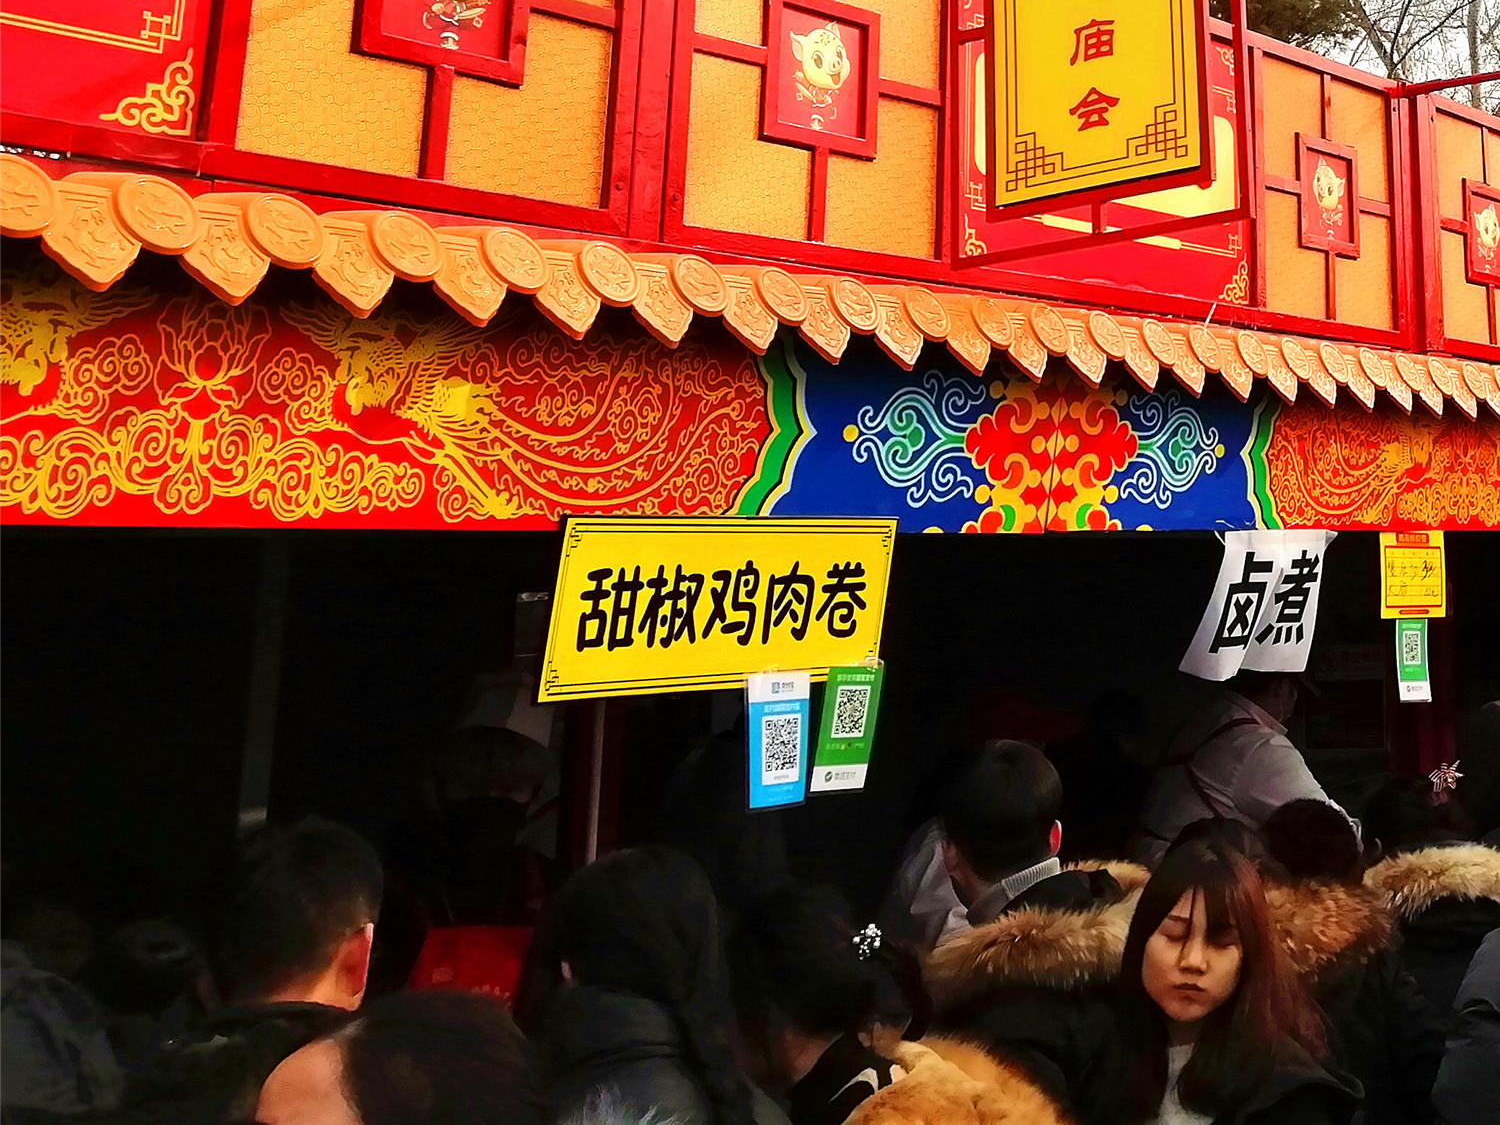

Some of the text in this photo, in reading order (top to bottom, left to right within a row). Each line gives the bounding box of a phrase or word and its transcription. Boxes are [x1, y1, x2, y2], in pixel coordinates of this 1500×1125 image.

[576, 559, 867, 653] 甜椒鸡肉卷
[1208, 549, 1320, 654] 卤煮
